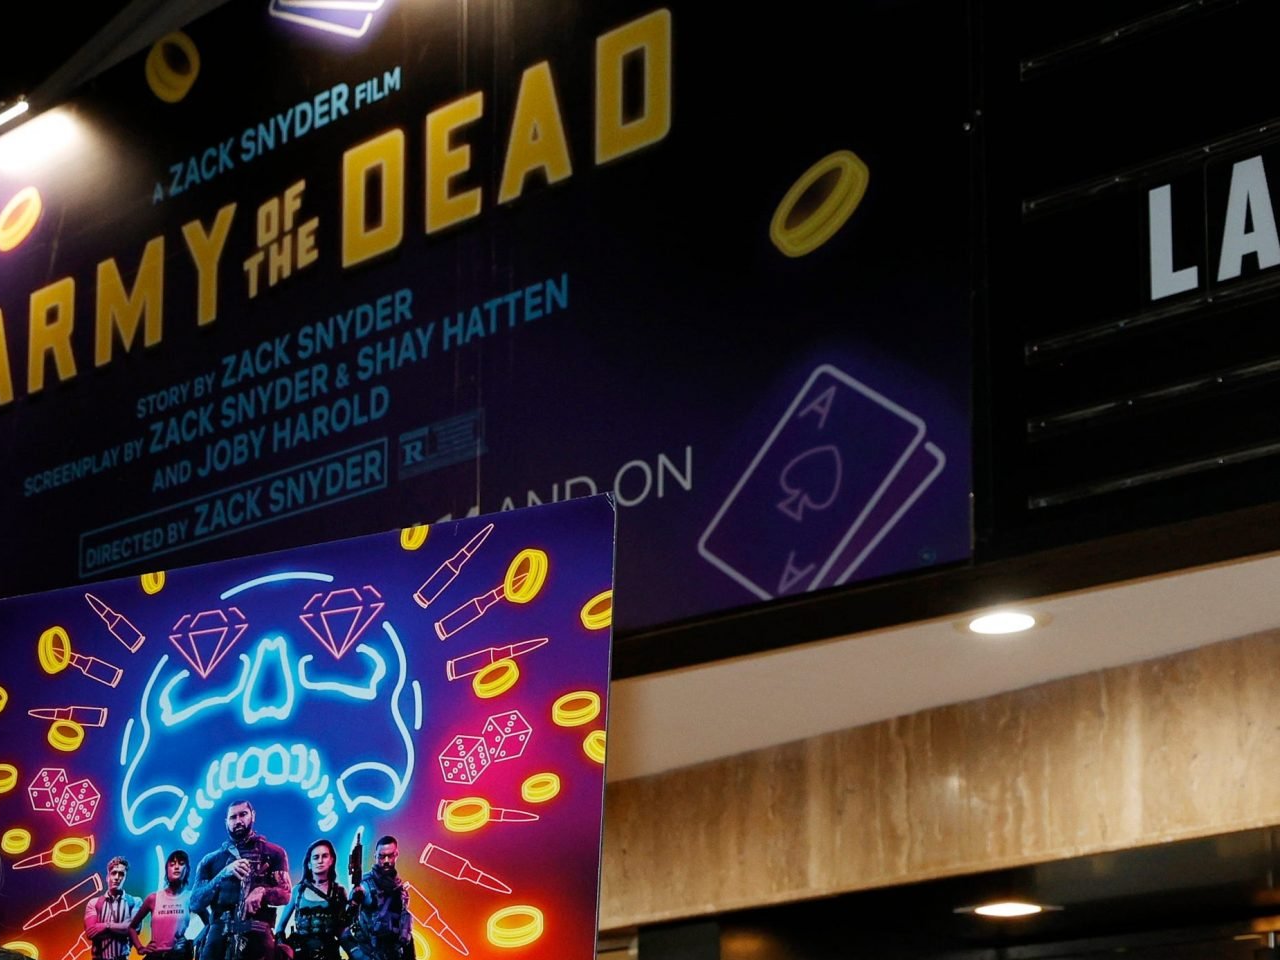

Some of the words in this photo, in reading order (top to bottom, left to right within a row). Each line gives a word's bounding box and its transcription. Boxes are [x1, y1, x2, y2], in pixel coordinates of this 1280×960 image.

[153, 182, 163, 205] A
[168, 137, 235, 196] ZACK
[240, 82, 350, 162] SNYDER
[354, 66, 401, 110] FILM
[342, 7, 672, 270] DEAD
[243, 216, 319, 298] THE
[256, 179, 306, 246] OF
[24, 447, 120, 496] SCREENPLAY
[123, 437, 144, 464] BY
[148, 403, 215, 454] ZACK
[220, 363, 328, 428] SNYDER
[335, 363, 349, 388] &
[357, 322, 436, 381] SHAY
[442, 272, 568, 351] HATTEN
[136, 380, 190, 419] STORY
[194, 372, 216, 398] BY
[221, 333, 291, 388] ZACK
[298, 288, 412, 360] SNYDER
[152, 460, 192, 492] AND
[197, 426, 266, 478] JOBY
[272, 385, 390, 452] HAROLD
[614, 446, 692, 507] ON
[86, 527, 164, 569] DIRECTED
[168, 519, 188, 545] BY
[194, 486, 263, 537] ZACK
[270, 450, 382, 512] SNYDER
